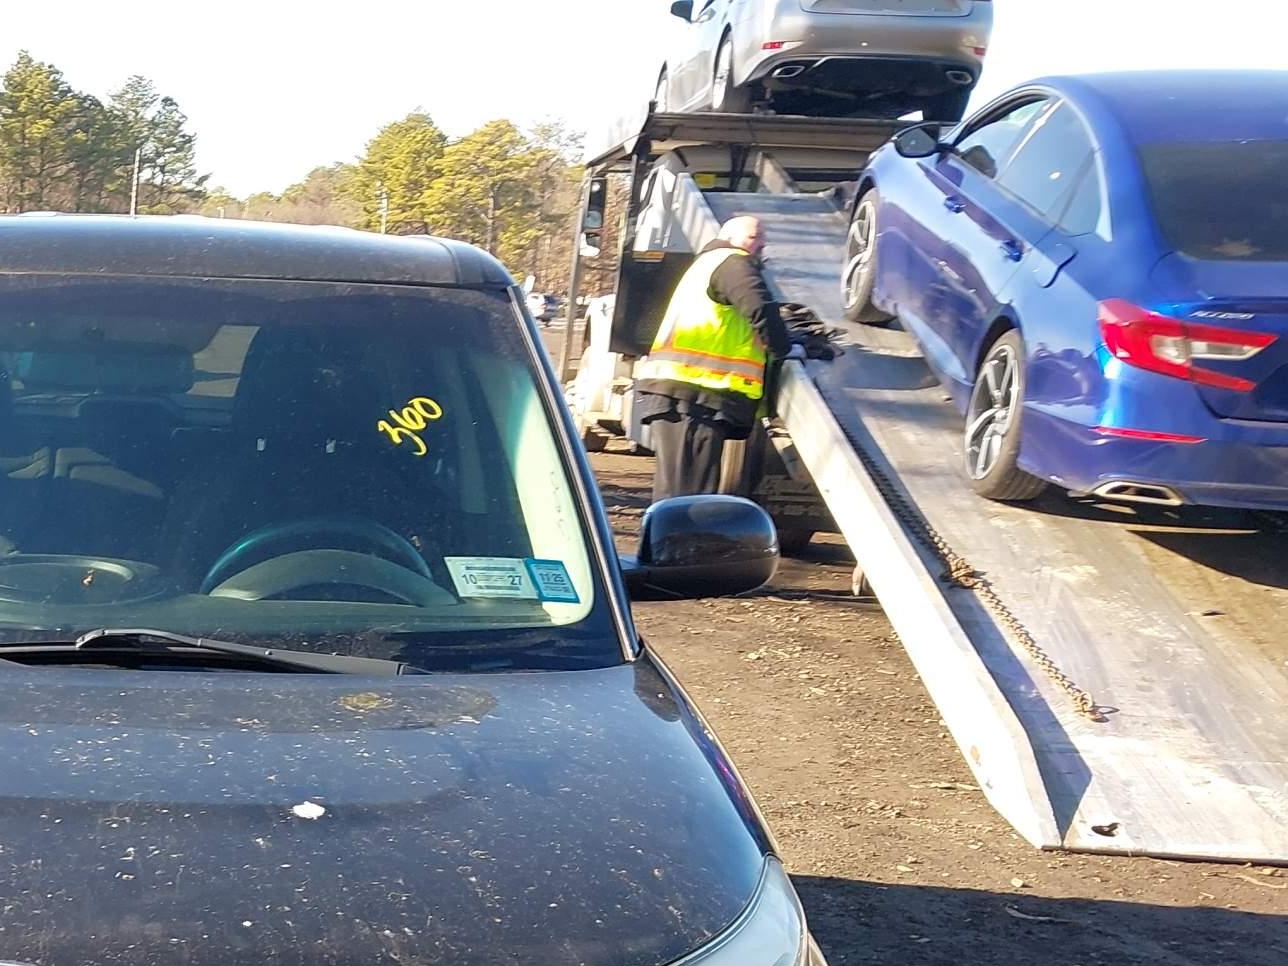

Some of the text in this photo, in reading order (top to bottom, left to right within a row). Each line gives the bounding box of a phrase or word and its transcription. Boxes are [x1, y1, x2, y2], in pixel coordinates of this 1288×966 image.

[377, 396, 444, 457] 360
[461, 574, 523, 586] 10 27
